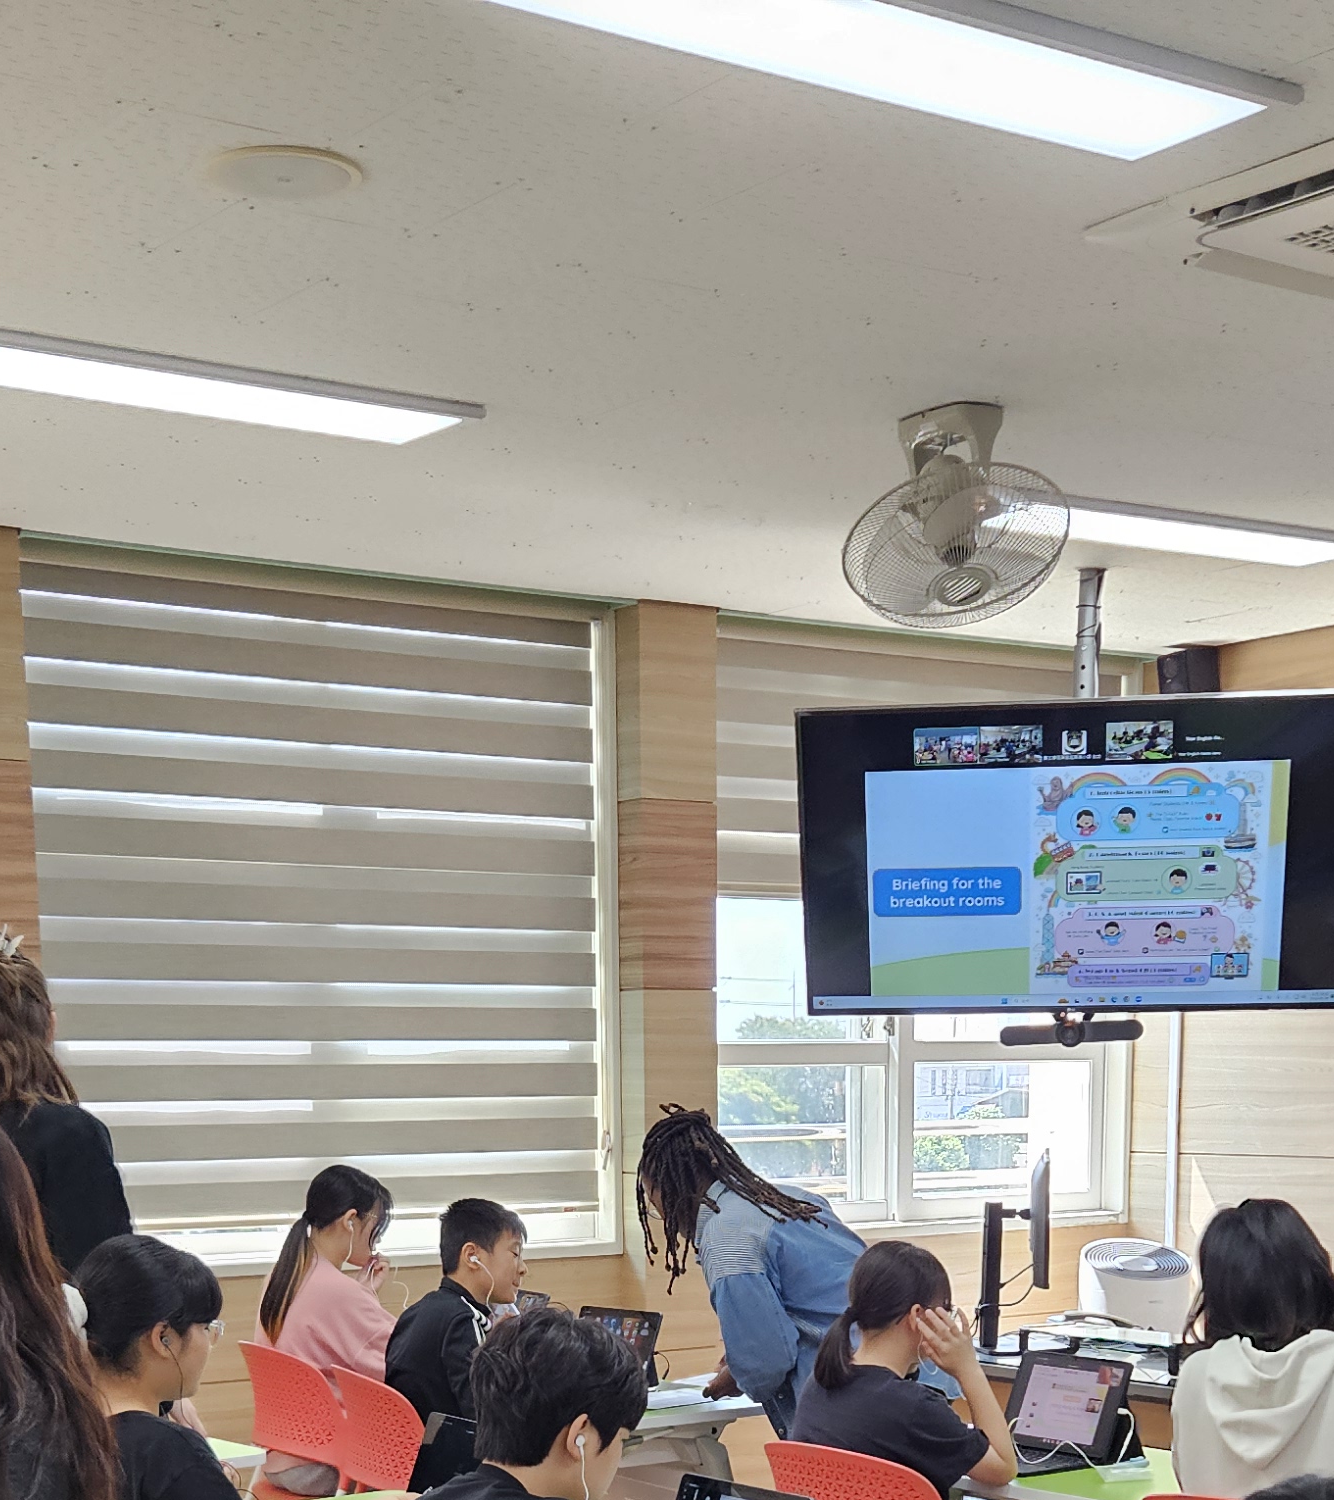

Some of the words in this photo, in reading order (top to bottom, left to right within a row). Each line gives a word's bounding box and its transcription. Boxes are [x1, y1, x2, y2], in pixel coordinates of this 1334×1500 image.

[892, 878, 948, 892] Briefing
[952, 877, 975, 890] for
[978, 876, 1003, 889] the
[890, 895, 955, 908] breakout
[959, 896, 1006, 907] rooms
